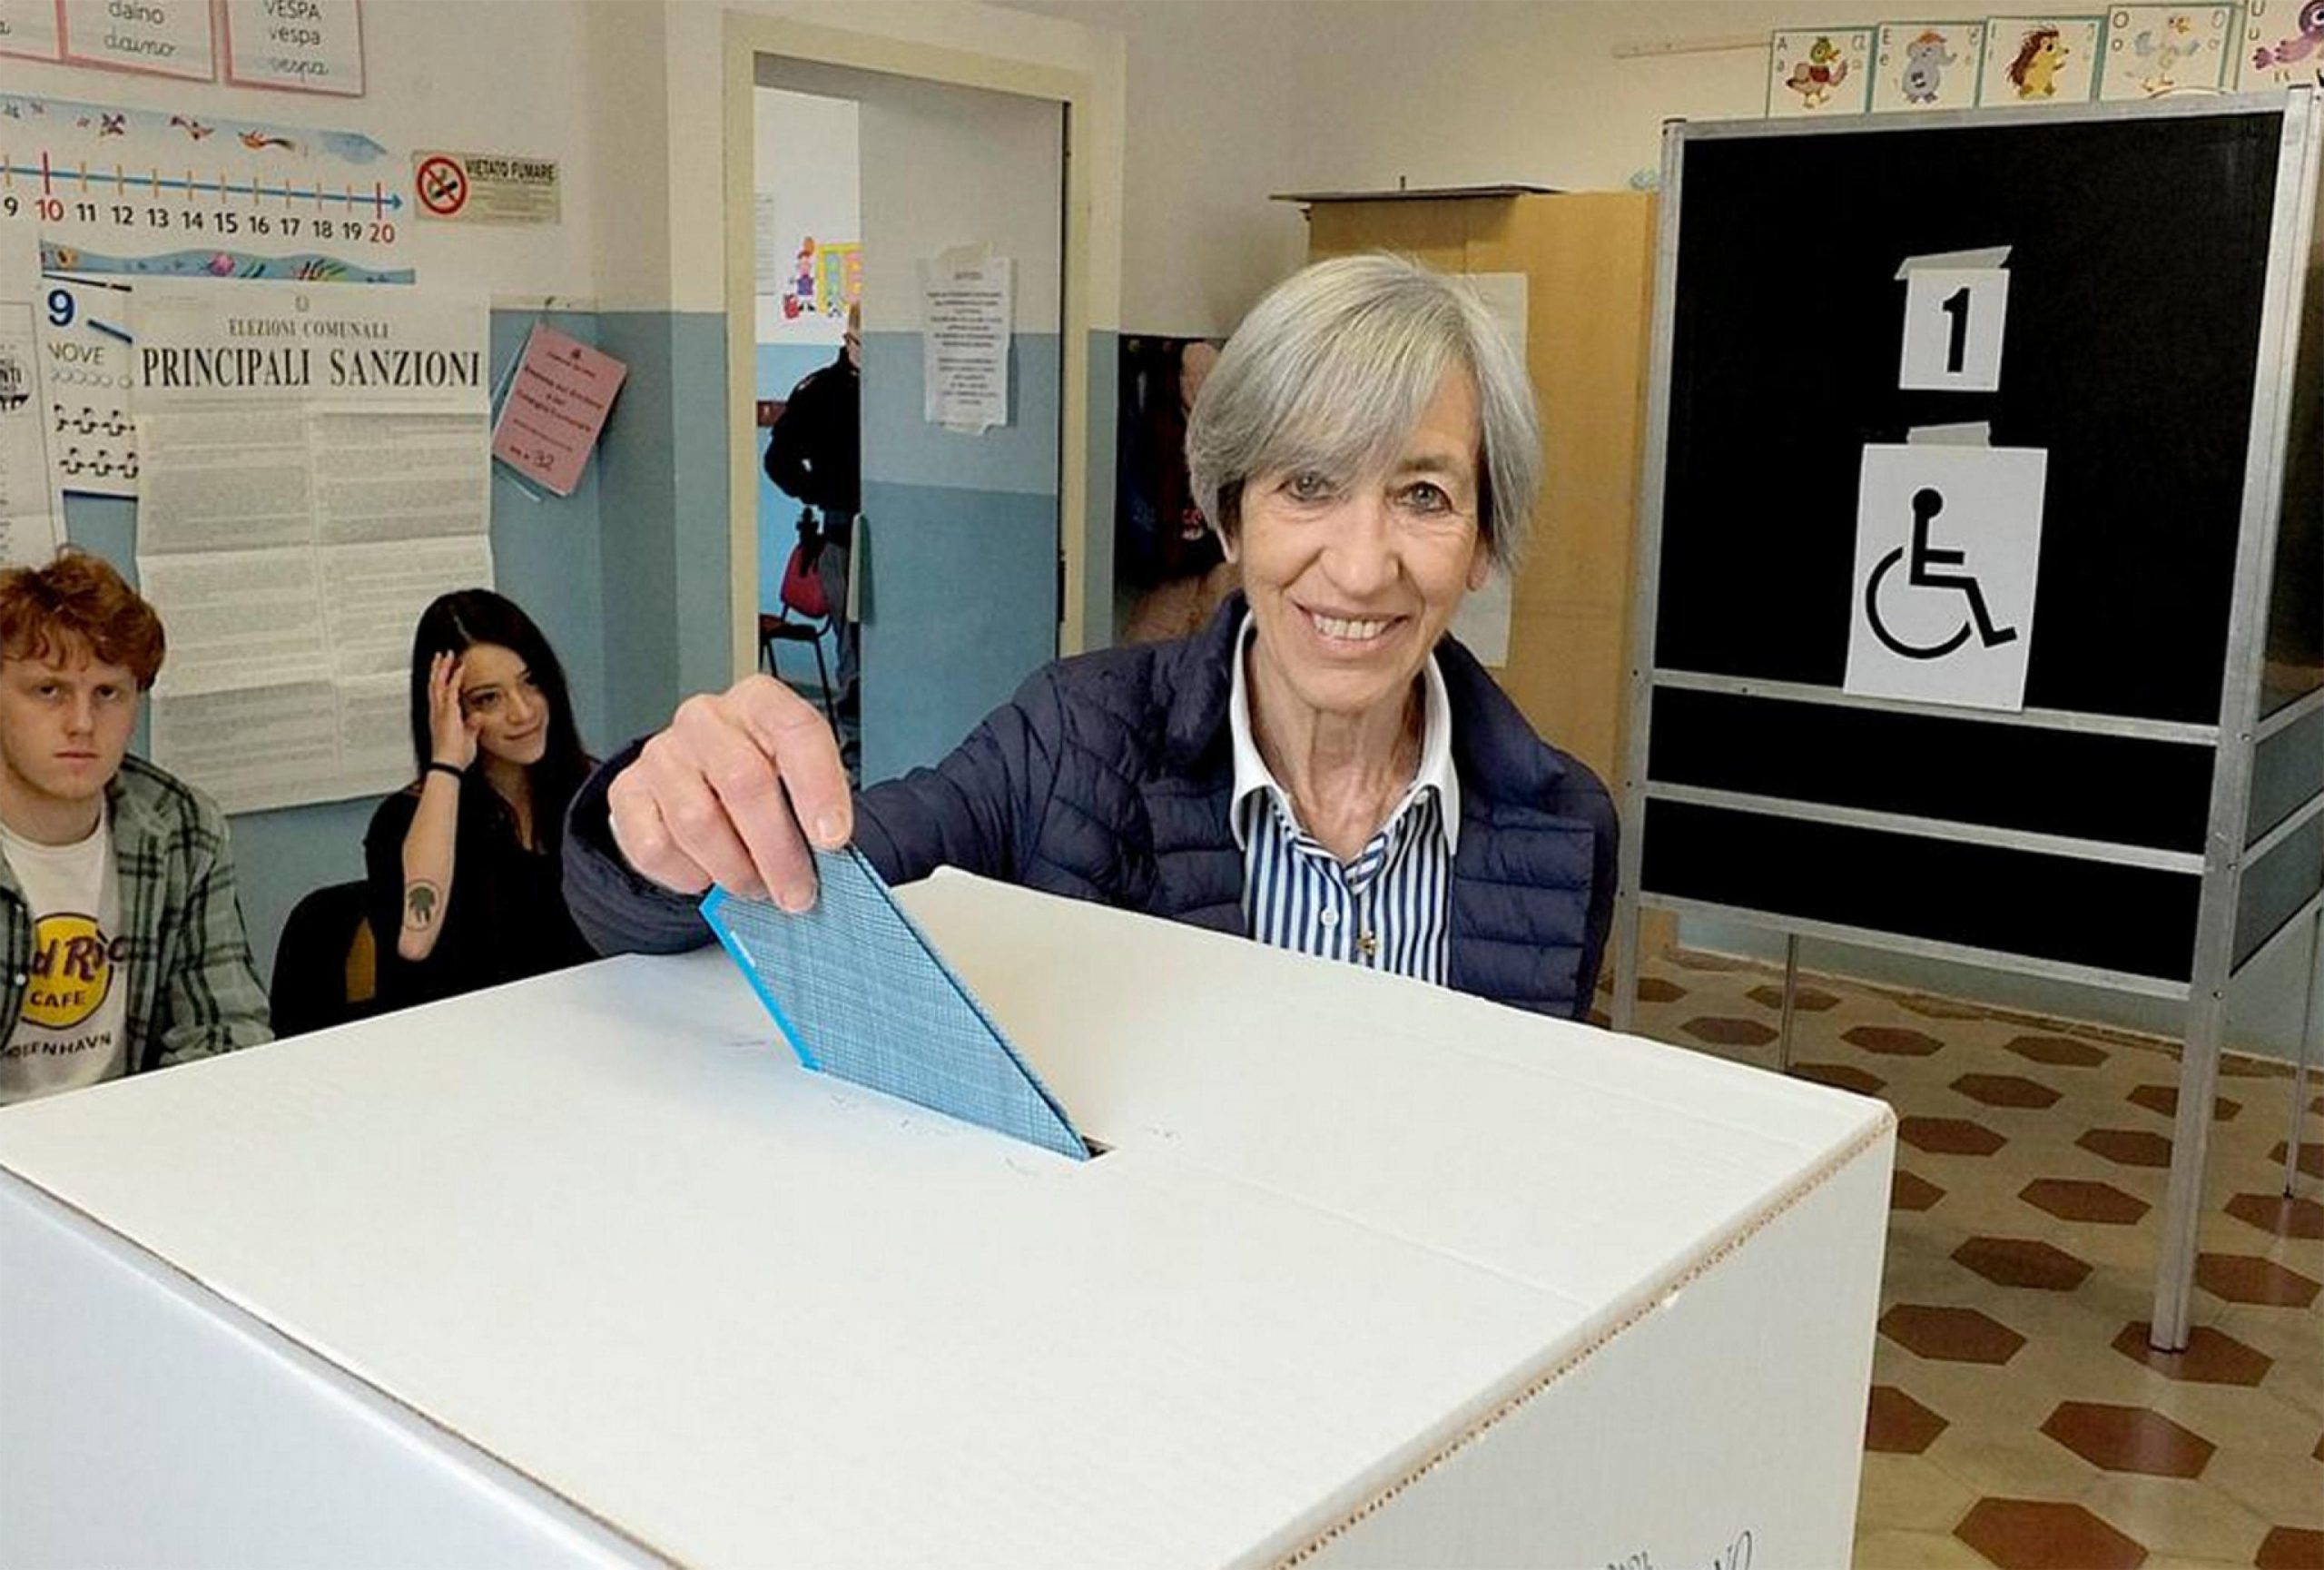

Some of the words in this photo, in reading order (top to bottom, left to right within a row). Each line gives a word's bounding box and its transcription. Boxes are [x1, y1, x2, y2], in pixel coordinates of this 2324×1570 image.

[465, 159, 508, 178] VIETATO
[511, 161, 555, 182] FUMARE
[4, 196, 18, 216] 9
[36, 200, 64, 222] 10
[77, 203, 96, 222] 11
[113, 206, 133, 225] 12
[148, 209, 169, 228] 13
[182, 211, 203, 230] 14
[215, 213, 238, 234] 15
[250, 217, 270, 235] 16
[281, 219, 300, 236] 17
[314, 221, 332, 239] 18
[342, 222, 361, 241] 19
[370, 223, 395, 243] 20
[48, 289, 74, 327] 9
[229, 319, 296, 337] ELEZIONI
[302, 321, 389, 340] COMUNALI
[1943, 287, 1970, 373] 1
[142, 347, 310, 388] PRINCIPALI
[330, 349, 479, 388] SANZIONI
[30, 990, 86, 1008] CAFE
